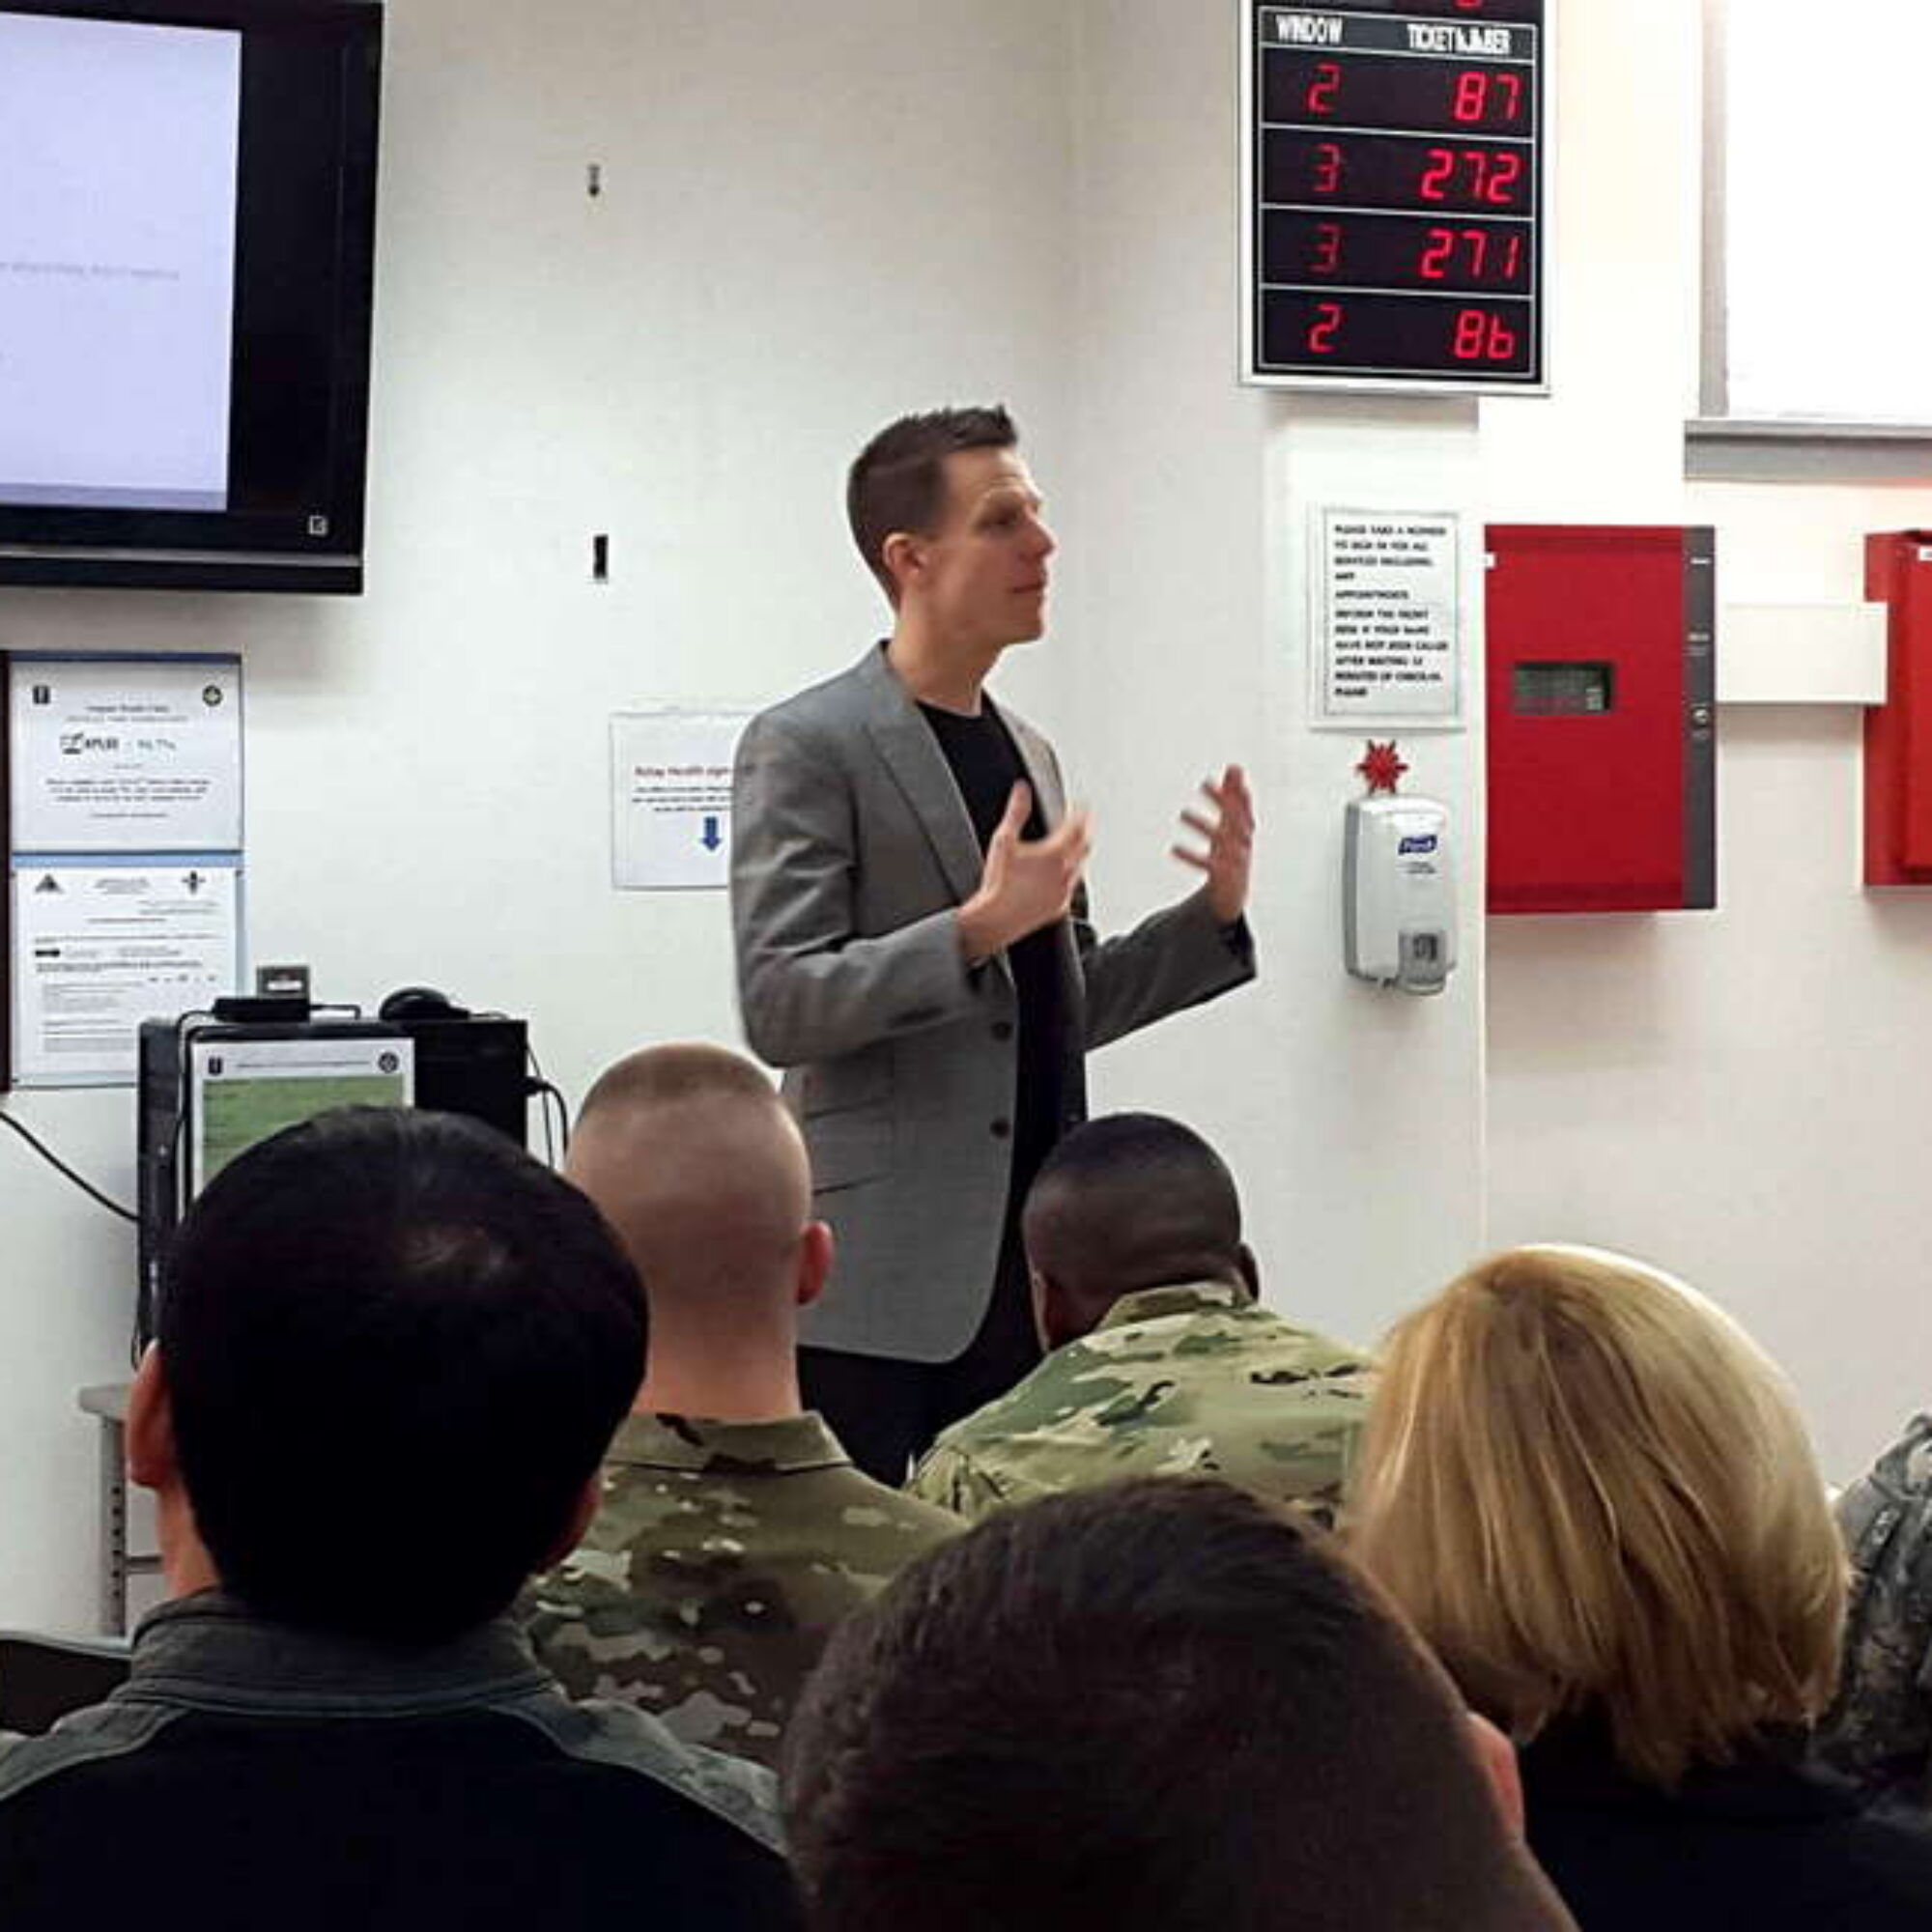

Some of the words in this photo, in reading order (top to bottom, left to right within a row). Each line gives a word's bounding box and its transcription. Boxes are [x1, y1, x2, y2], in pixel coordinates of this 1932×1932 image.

[1276, 15, 1343, 44] WINDOW
[1406, 24, 1455, 52] TICKET
[1307, 62, 1341, 114] 2
[1454, 71, 1520, 122] 87
[1311, 142, 1341, 193] 3
[1420, 148, 1521, 204] 272
[1309, 223, 1341, 273] 3
[1420, 228, 1520, 280] 271
[1307, 302, 1343, 354] 2
